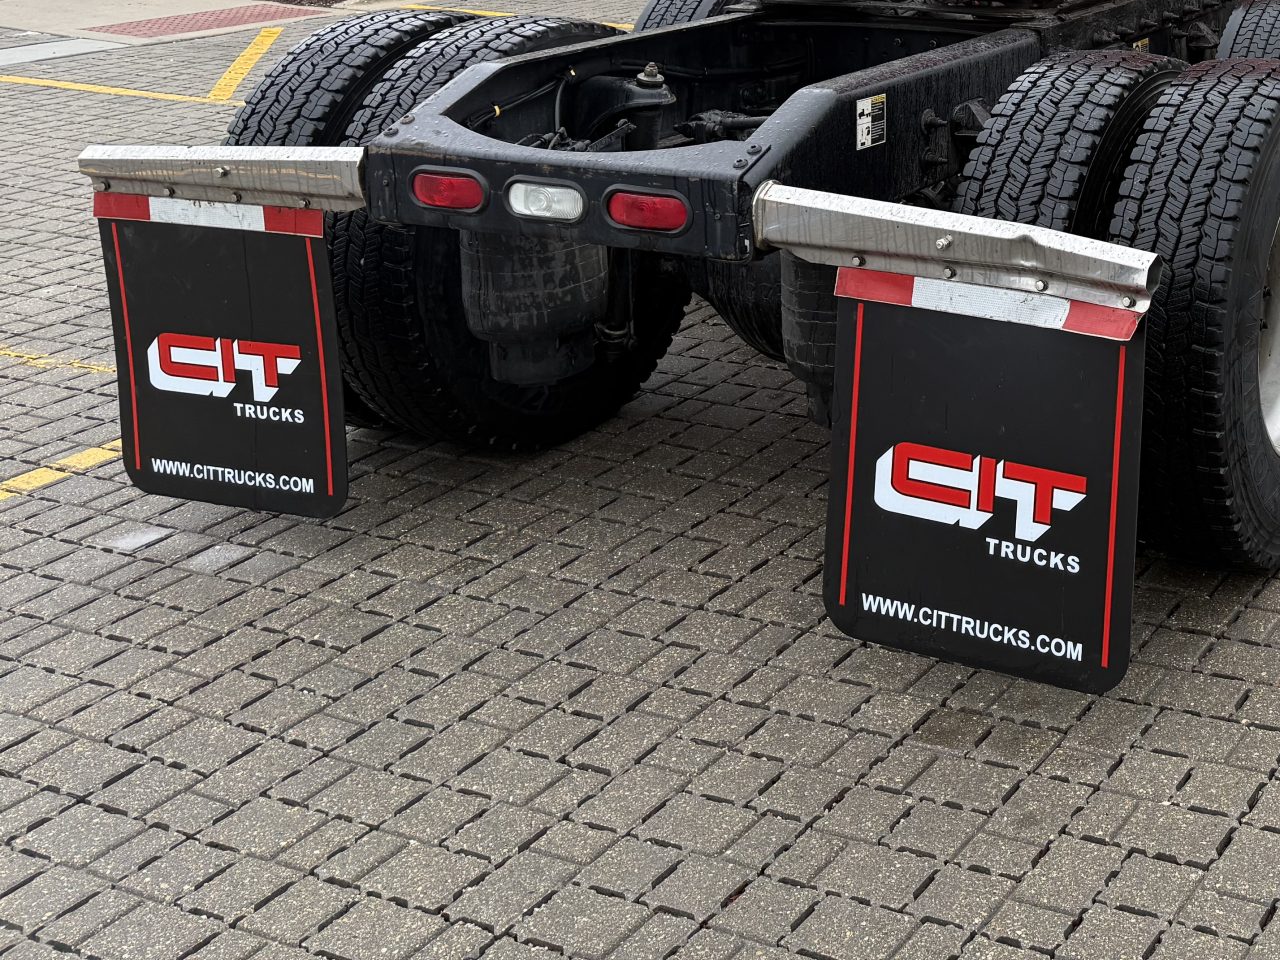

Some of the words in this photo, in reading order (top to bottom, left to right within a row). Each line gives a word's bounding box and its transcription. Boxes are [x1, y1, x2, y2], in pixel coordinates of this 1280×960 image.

[147, 332, 302, 403] CIT
[233, 402, 305, 424] TRUCKS
[151, 457, 315, 494] WWW.CITTRUCKS.COM
[873, 441, 1088, 543] CIT
[985, 537, 1081, 574] TRUCKS
[861, 592, 1083, 662] WWW.CITTRUCKS.COM
